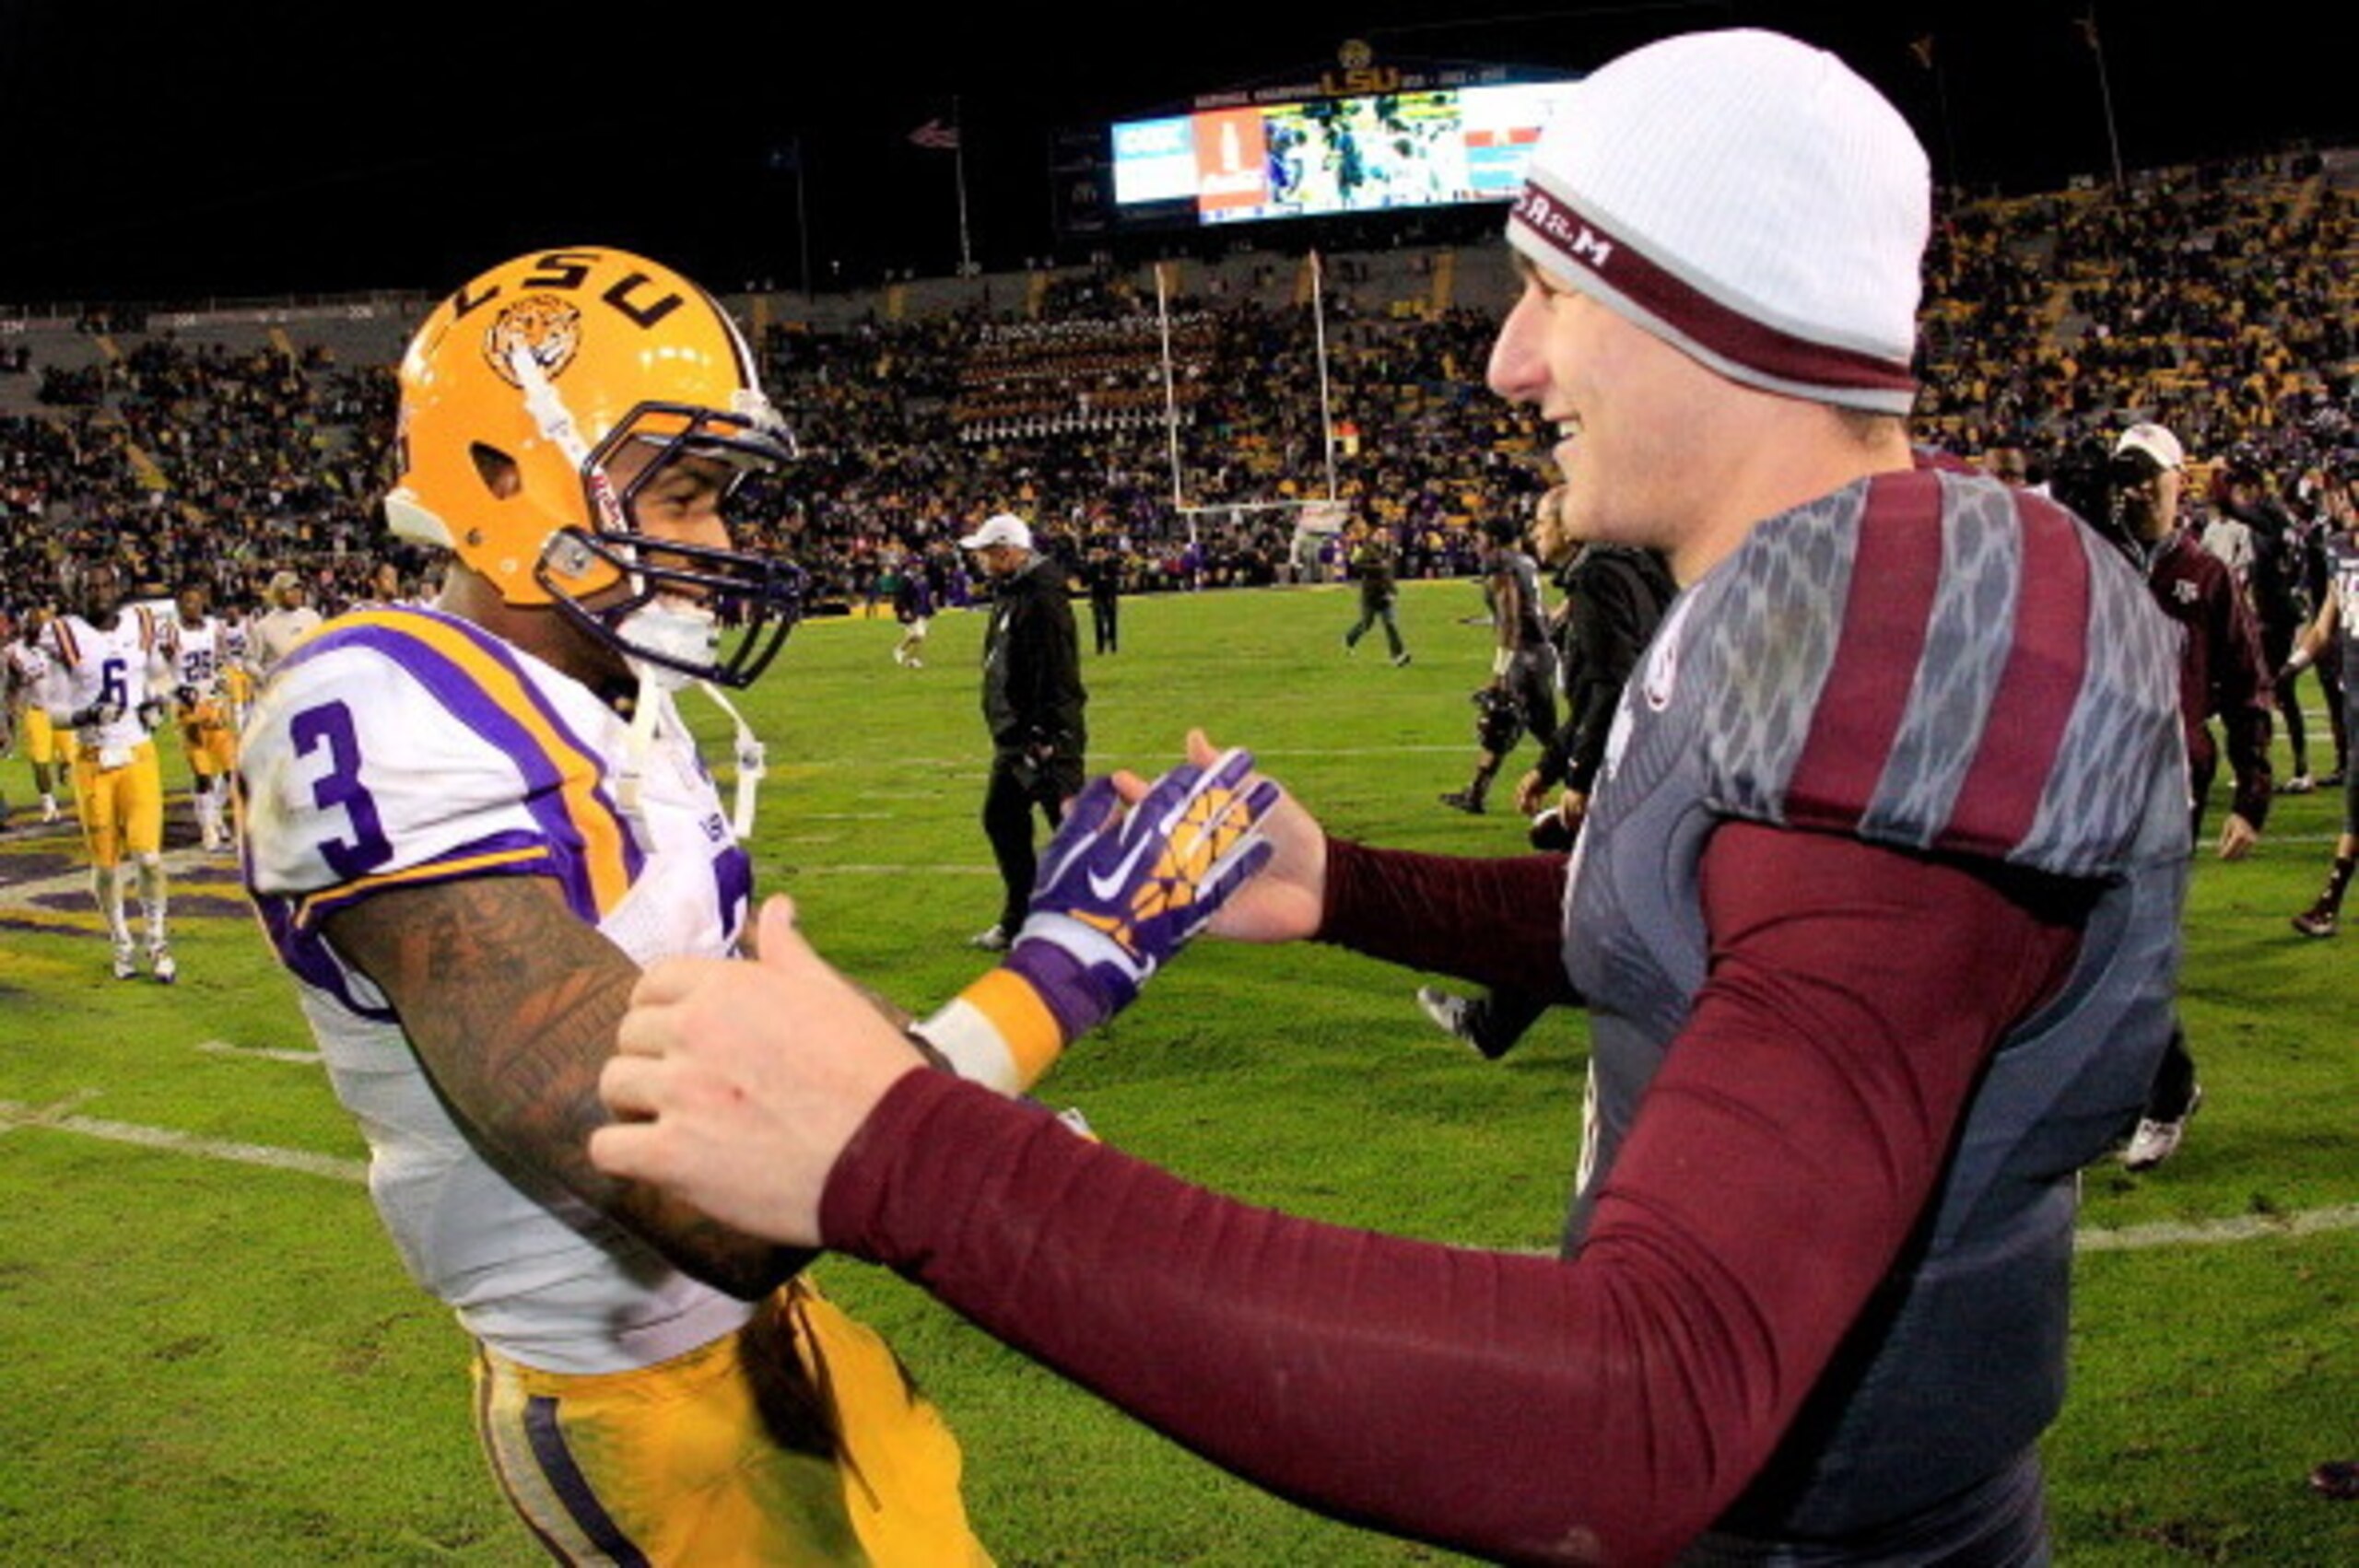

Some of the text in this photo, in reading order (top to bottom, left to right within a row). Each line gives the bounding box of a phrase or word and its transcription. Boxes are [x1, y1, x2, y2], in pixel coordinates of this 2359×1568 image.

[1321, 66, 1399, 94] LSU
[455, 252, 685, 330] LSU
[101, 658, 129, 708] 6
[289, 698, 394, 879] 3
